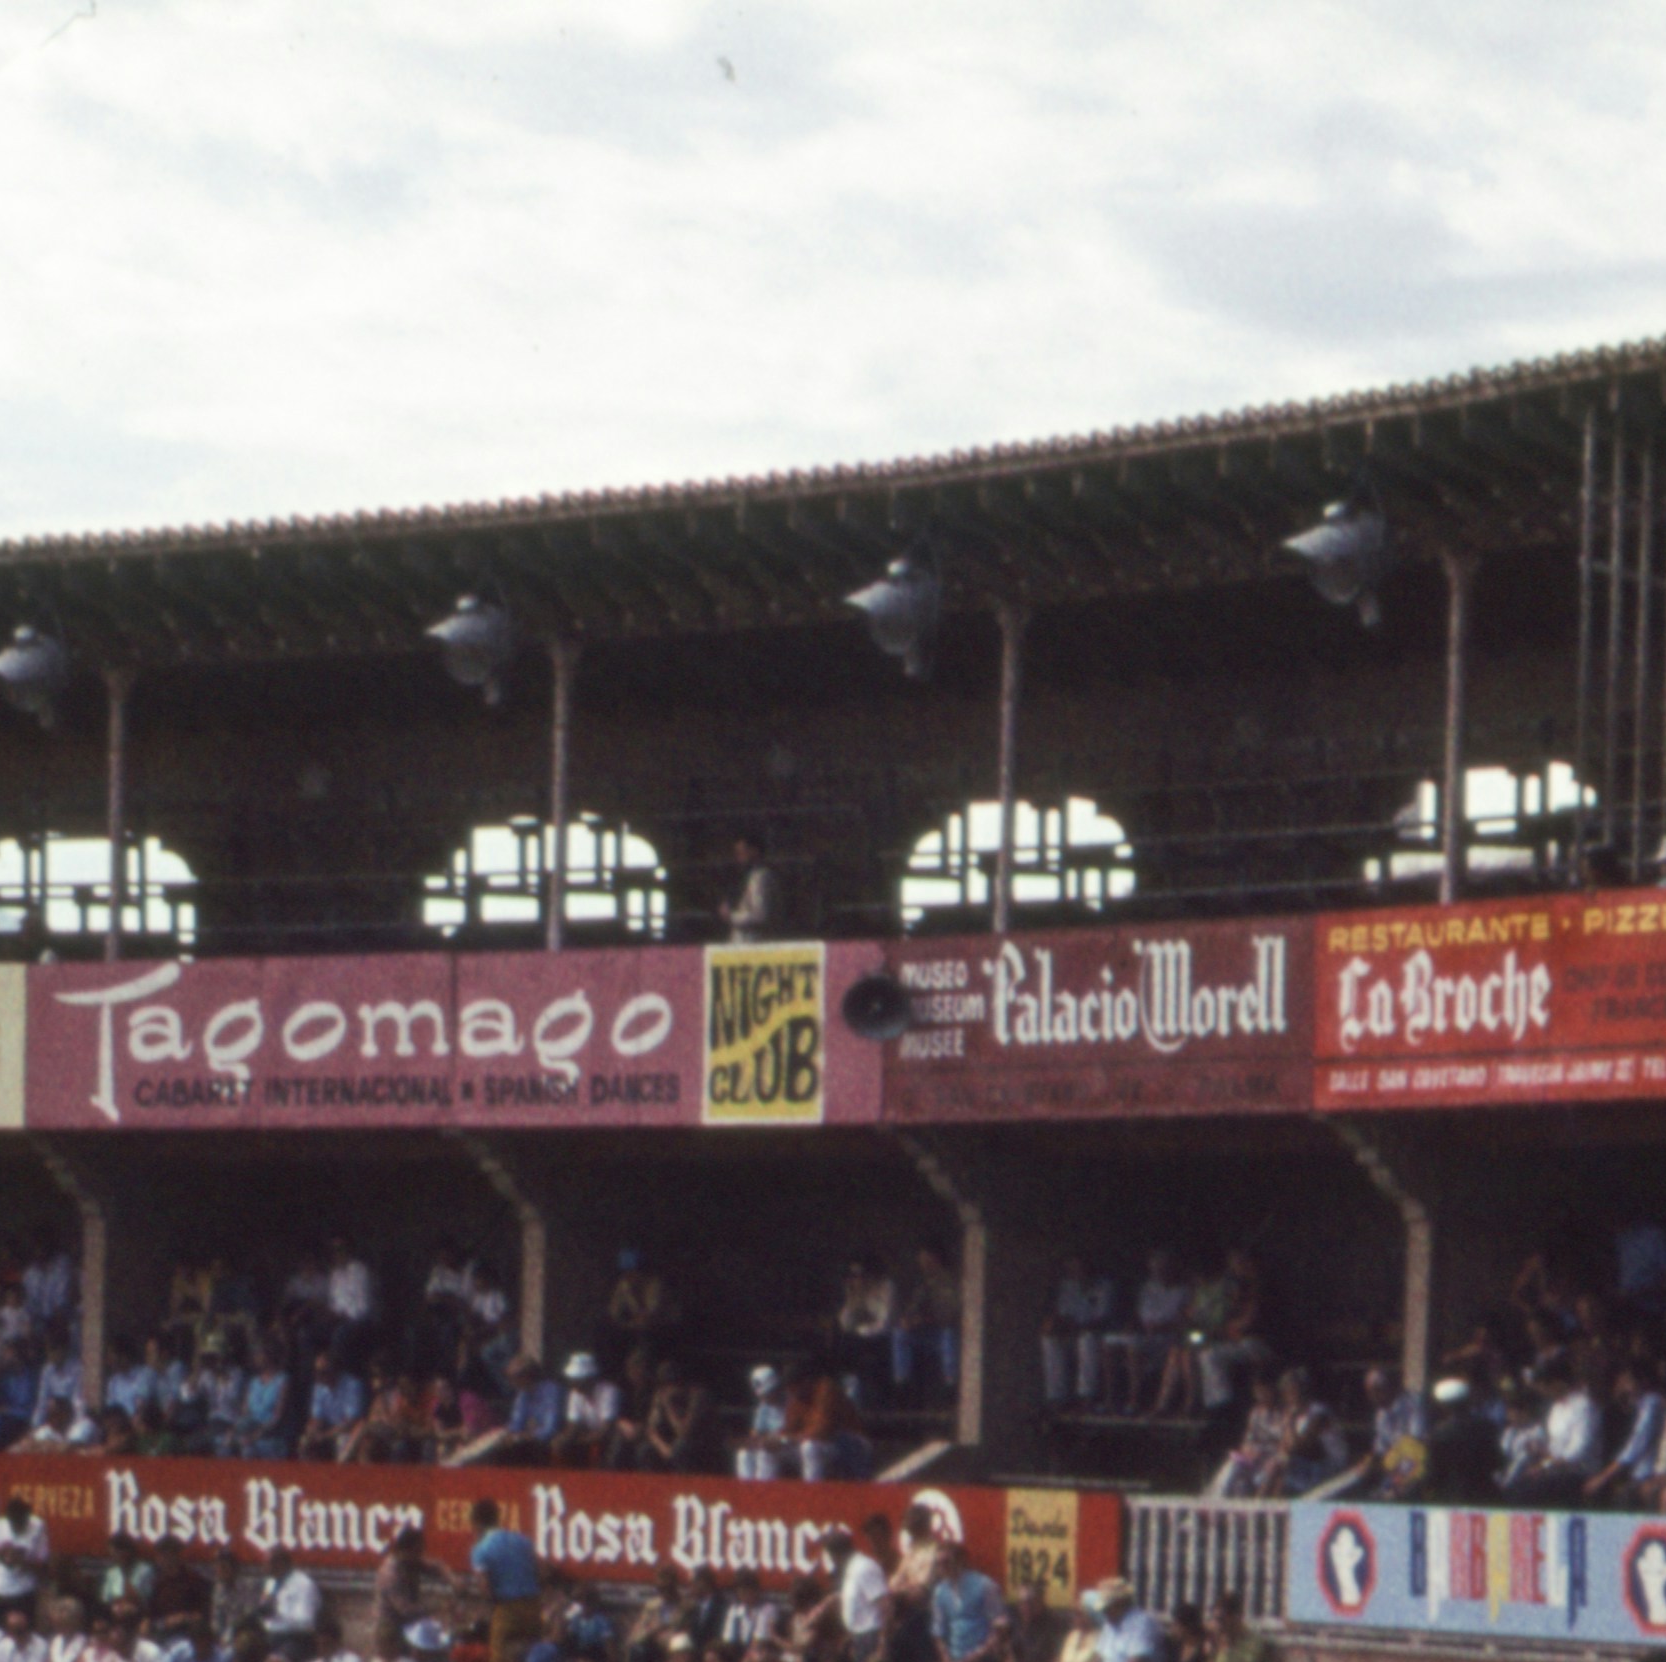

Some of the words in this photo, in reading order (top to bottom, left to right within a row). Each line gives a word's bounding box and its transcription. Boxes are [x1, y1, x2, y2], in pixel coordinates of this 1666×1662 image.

[1329, 913, 1550, 952] RESTAURANTE
[900, 960, 968, 990] MUSEO
[914, 994, 985, 1022] USEUM
[982, 940, 1137, 1046] Palacio
[1132, 934, 1287, 1053] Morell
[1339, 956, 1394, 1053] La
[1400, 948, 1552, 1046] Broche
[54, 962, 674, 1122] Tagomago
[709, 1016, 818, 1104] CLUB
[106, 1469, 230, 1543] Rosa
[533, 1484, 658, 1562] Rosa
[1008, 1546, 1069, 1590] 1924
